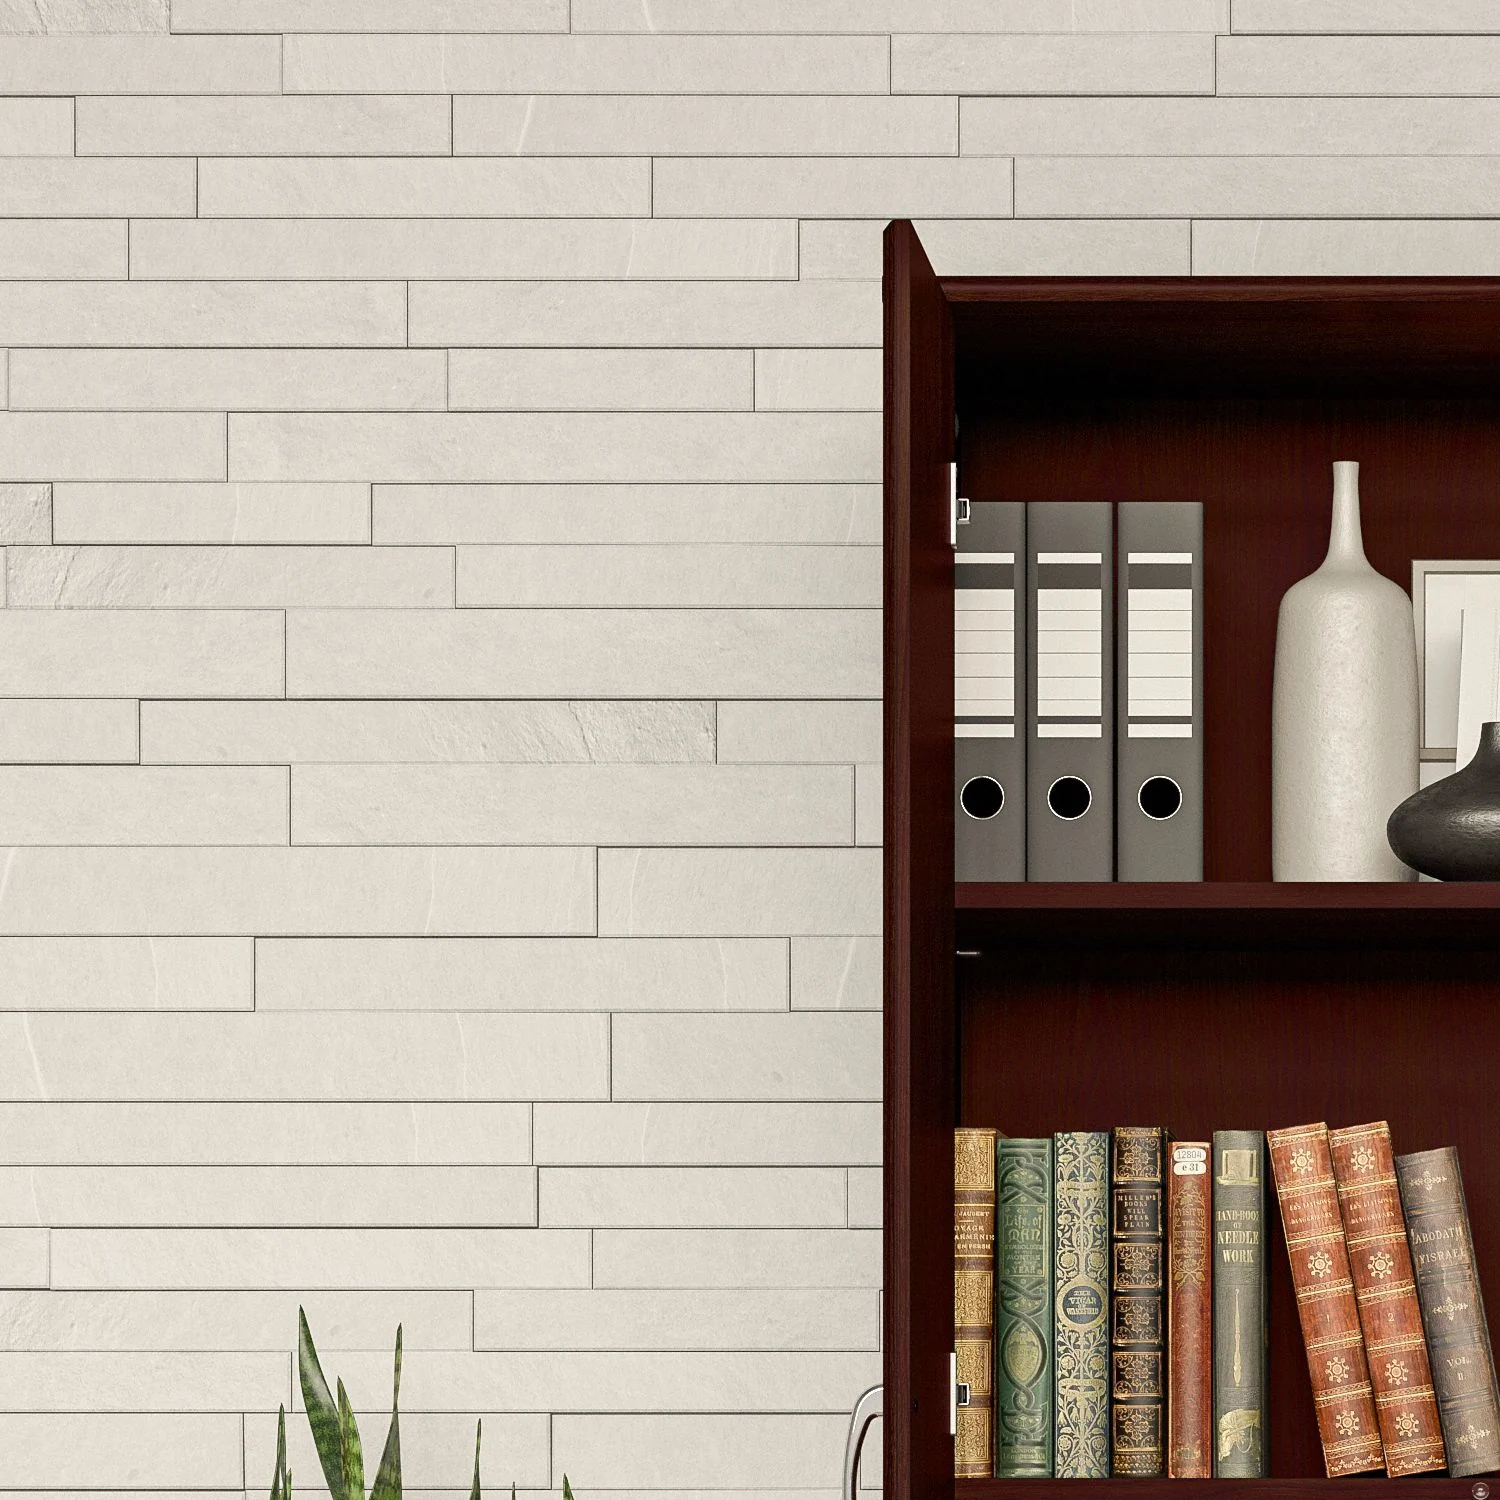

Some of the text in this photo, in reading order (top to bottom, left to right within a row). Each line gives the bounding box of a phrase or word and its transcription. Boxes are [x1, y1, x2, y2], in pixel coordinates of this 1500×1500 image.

[1177, 1150, 1202, 1159] 12804
[1189, 1163, 1199, 1171] 31
[1005, 1214, 1042, 1229] Life of
[1217, 1230, 1259, 1245] NEEDLE
[1222, 1249, 1254, 1263] WORK
[1418, 1248, 1466, 1264] YISRAEL
[1068, 1296, 1097, 1305] VICAR
[1387, 1312, 1395, 1322] 2
